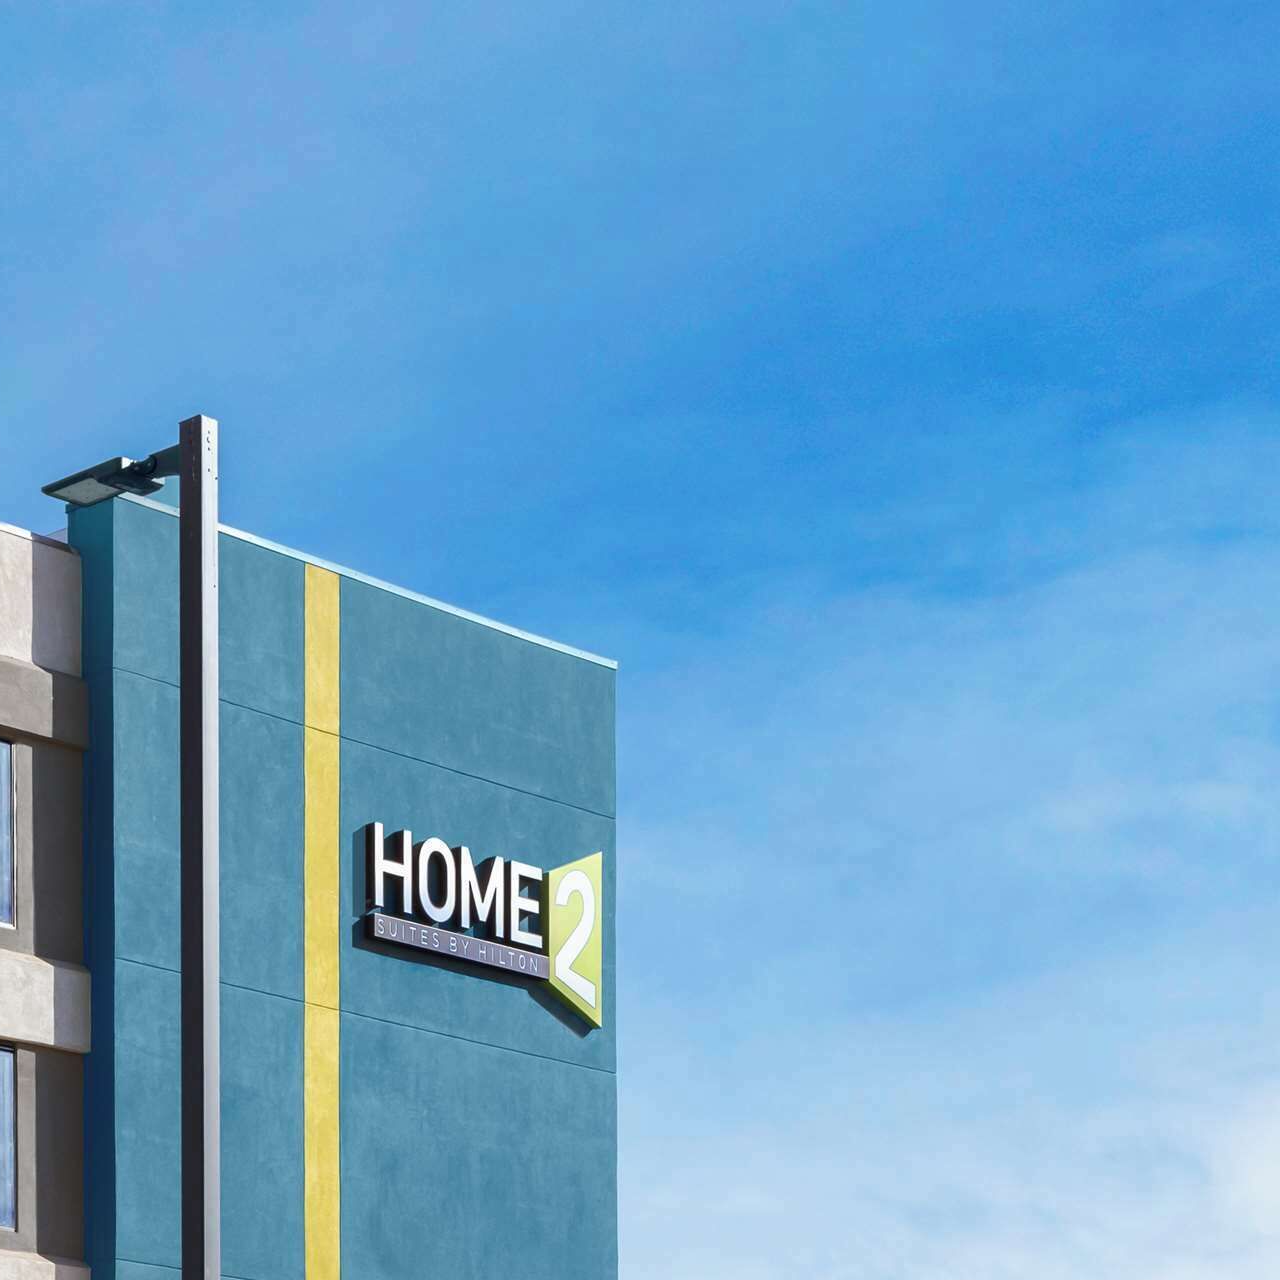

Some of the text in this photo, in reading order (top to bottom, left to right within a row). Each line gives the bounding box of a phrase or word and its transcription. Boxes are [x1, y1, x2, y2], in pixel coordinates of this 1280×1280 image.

[377, 918, 539, 972] SUITES BY HILTON
